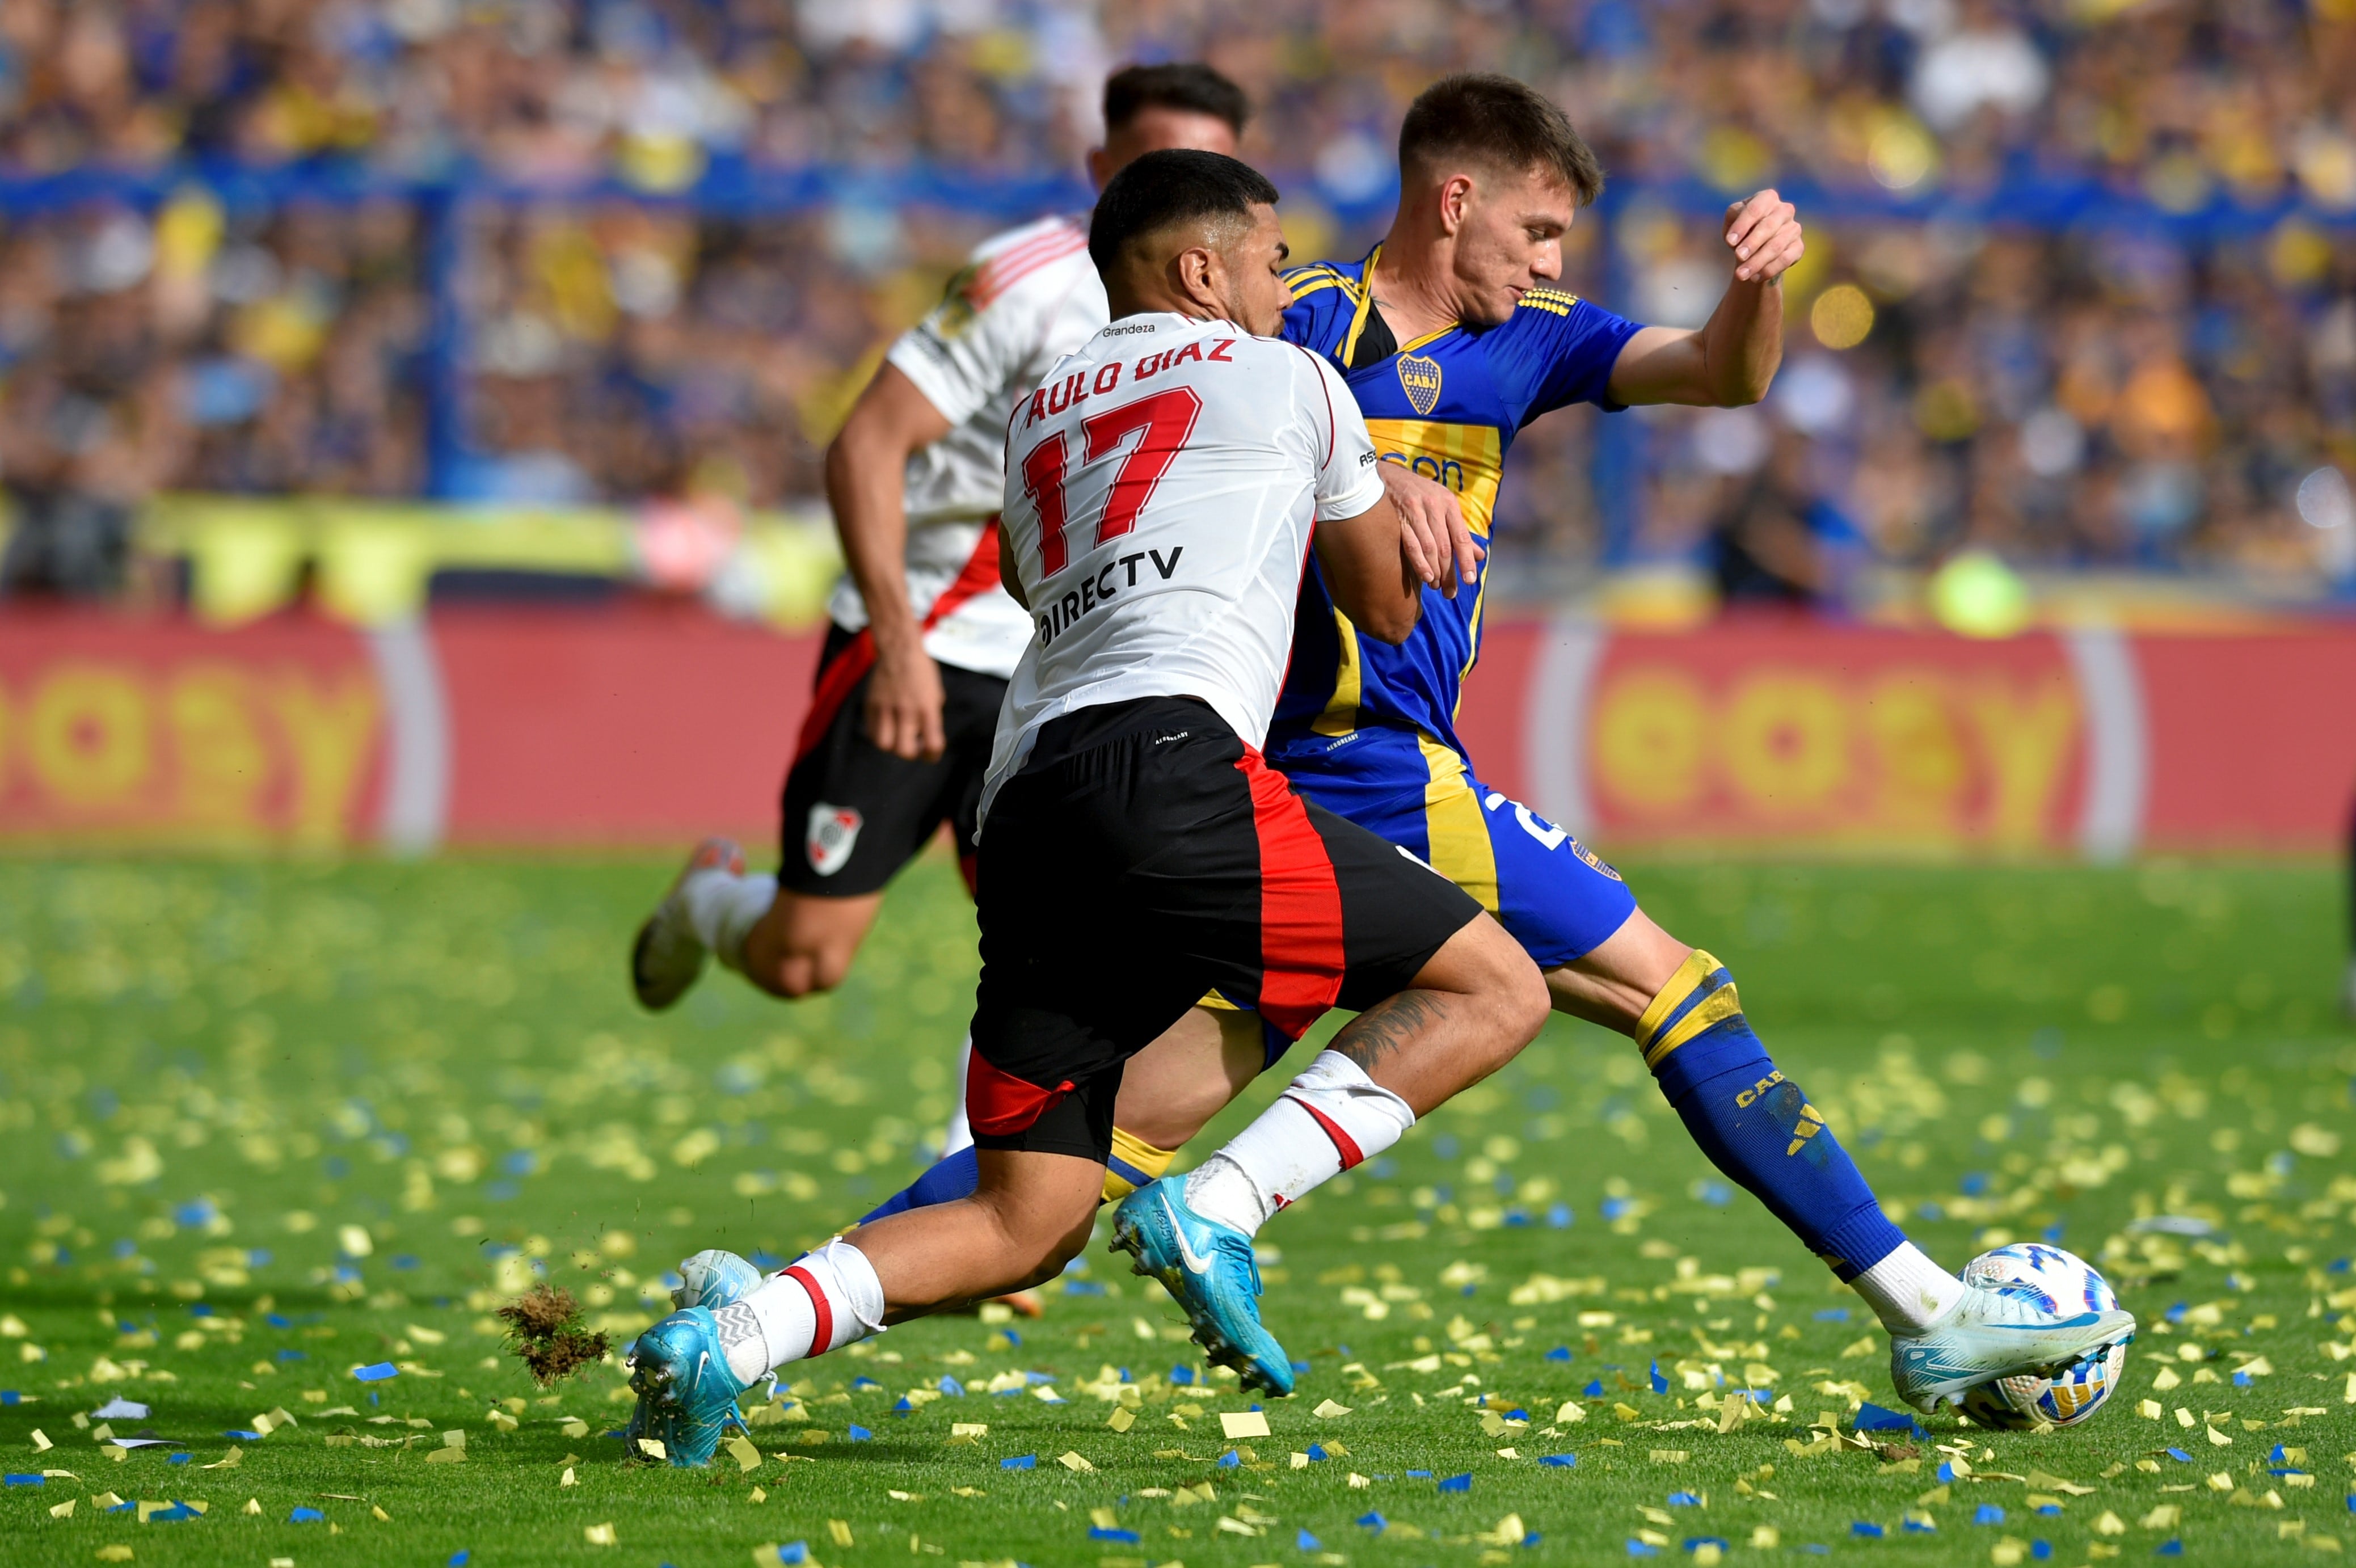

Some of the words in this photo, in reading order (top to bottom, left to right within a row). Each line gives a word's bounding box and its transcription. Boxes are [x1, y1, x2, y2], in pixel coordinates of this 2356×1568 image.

[1103, 324, 1155, 338] Grandeza
[1017, 361, 1123, 438] AULO
[1135, 338, 1237, 382] DIAZ
[1405, 373, 1436, 390] CABJ
[1021, 385, 1203, 586] 17
[1040, 546, 1184, 649] DIRECTV
[1326, 733, 1359, 752] AEROREADY
